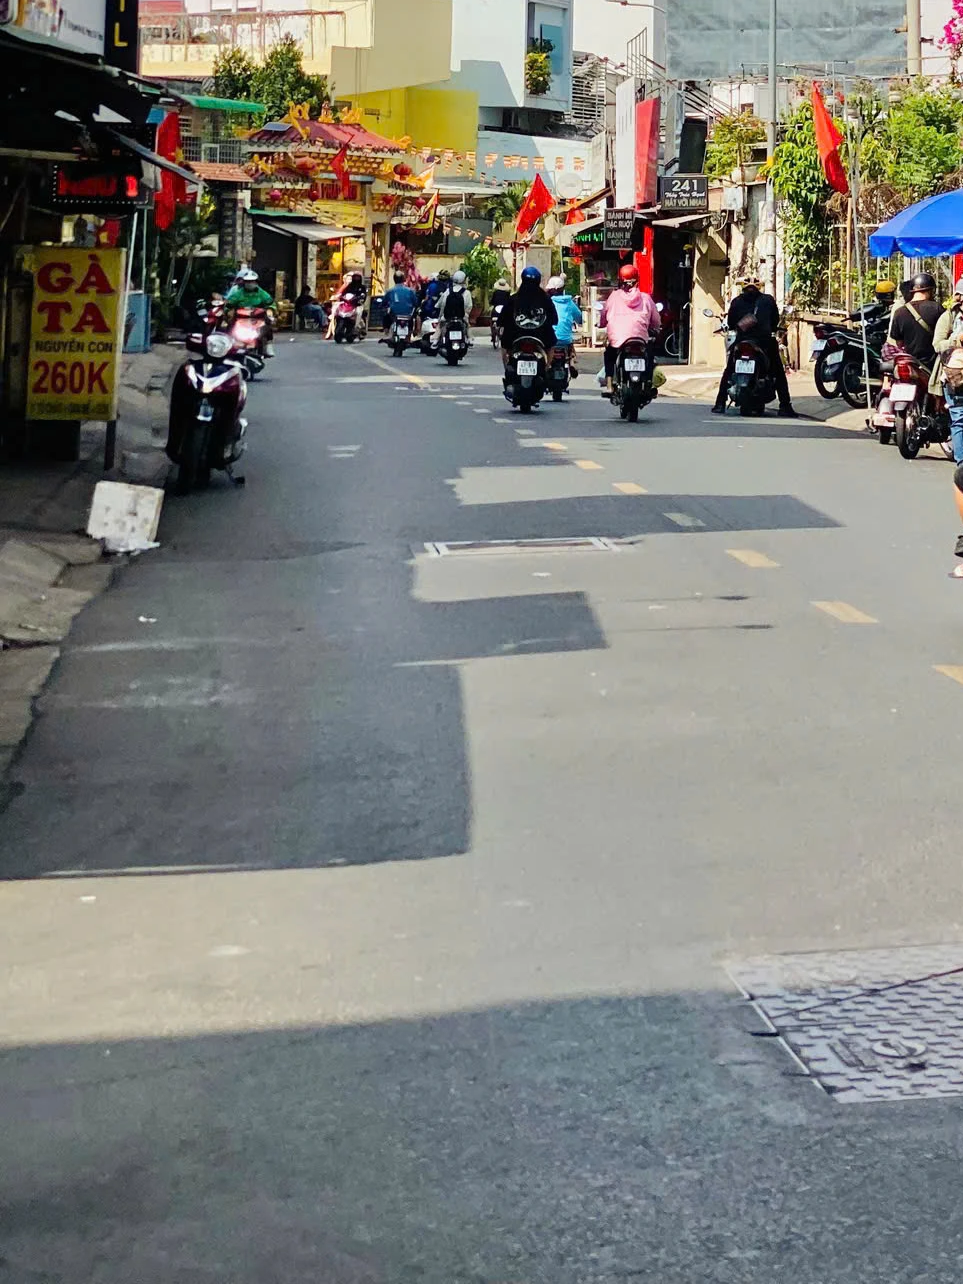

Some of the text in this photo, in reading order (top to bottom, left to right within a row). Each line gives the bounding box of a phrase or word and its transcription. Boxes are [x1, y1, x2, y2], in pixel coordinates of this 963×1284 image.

[671, 179, 698, 192] 241
[37, 253, 116, 295] GÀ
[36, 300, 111, 333] TA
[88, 341, 113, 353] CON
[32, 360, 110, 394] 260K
